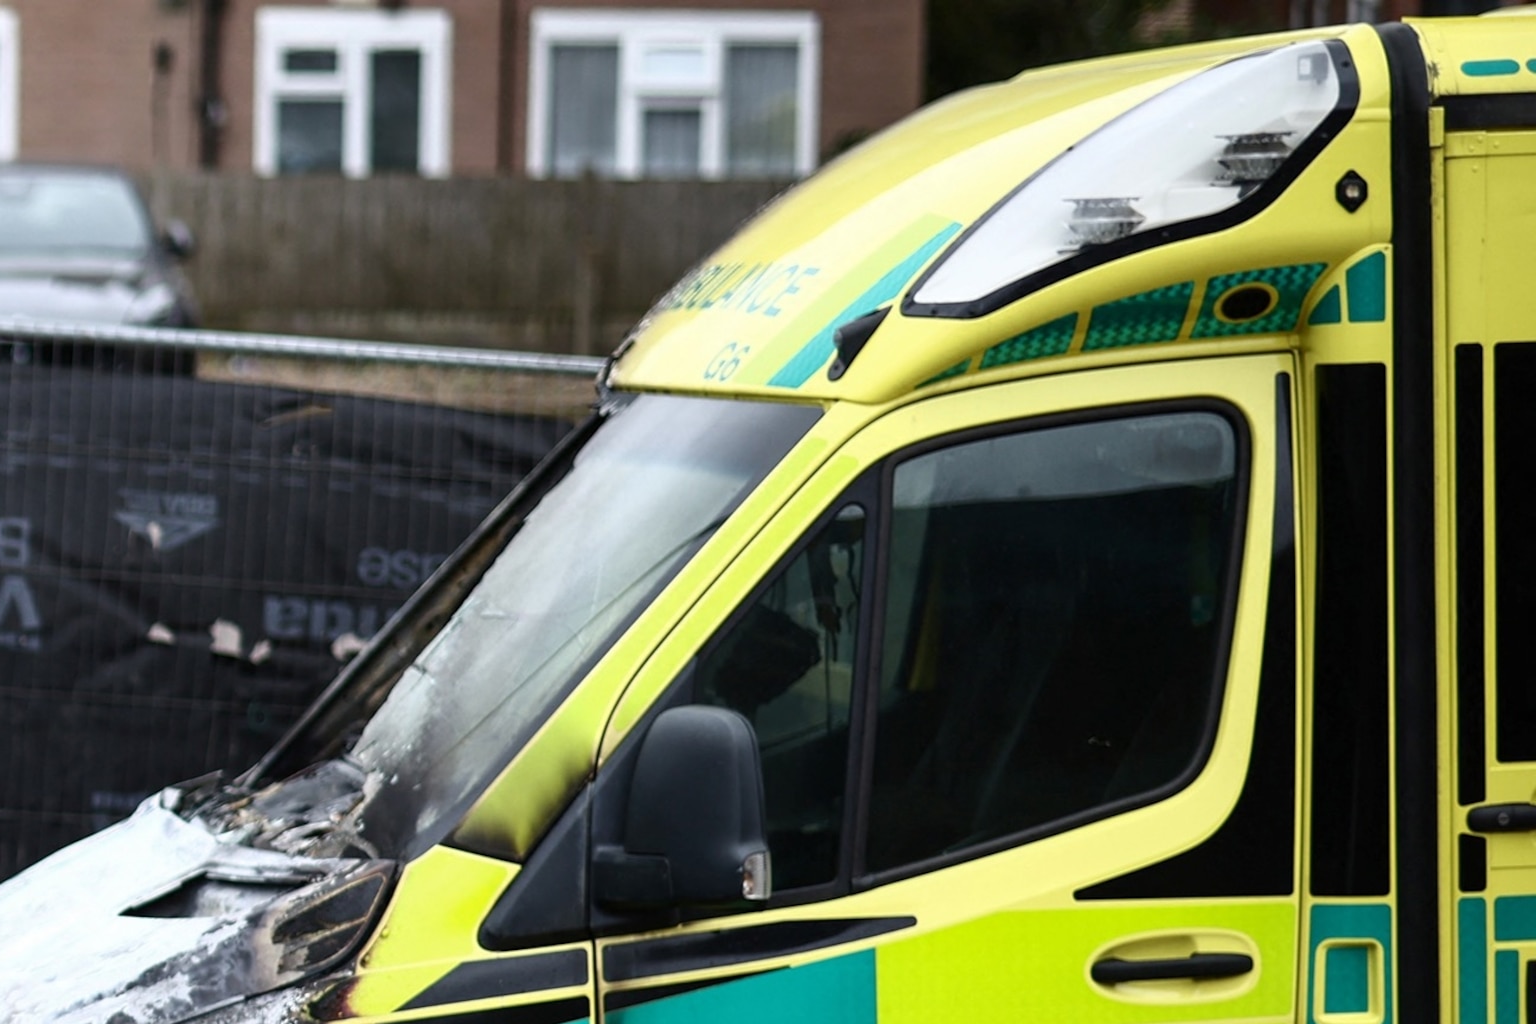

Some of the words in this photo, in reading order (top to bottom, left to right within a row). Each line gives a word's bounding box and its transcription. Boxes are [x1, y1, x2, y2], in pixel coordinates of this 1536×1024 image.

[658, 262, 820, 317] BULANCE
[703, 342, 749, 381] G6
[263, 595, 396, 642] ntia
